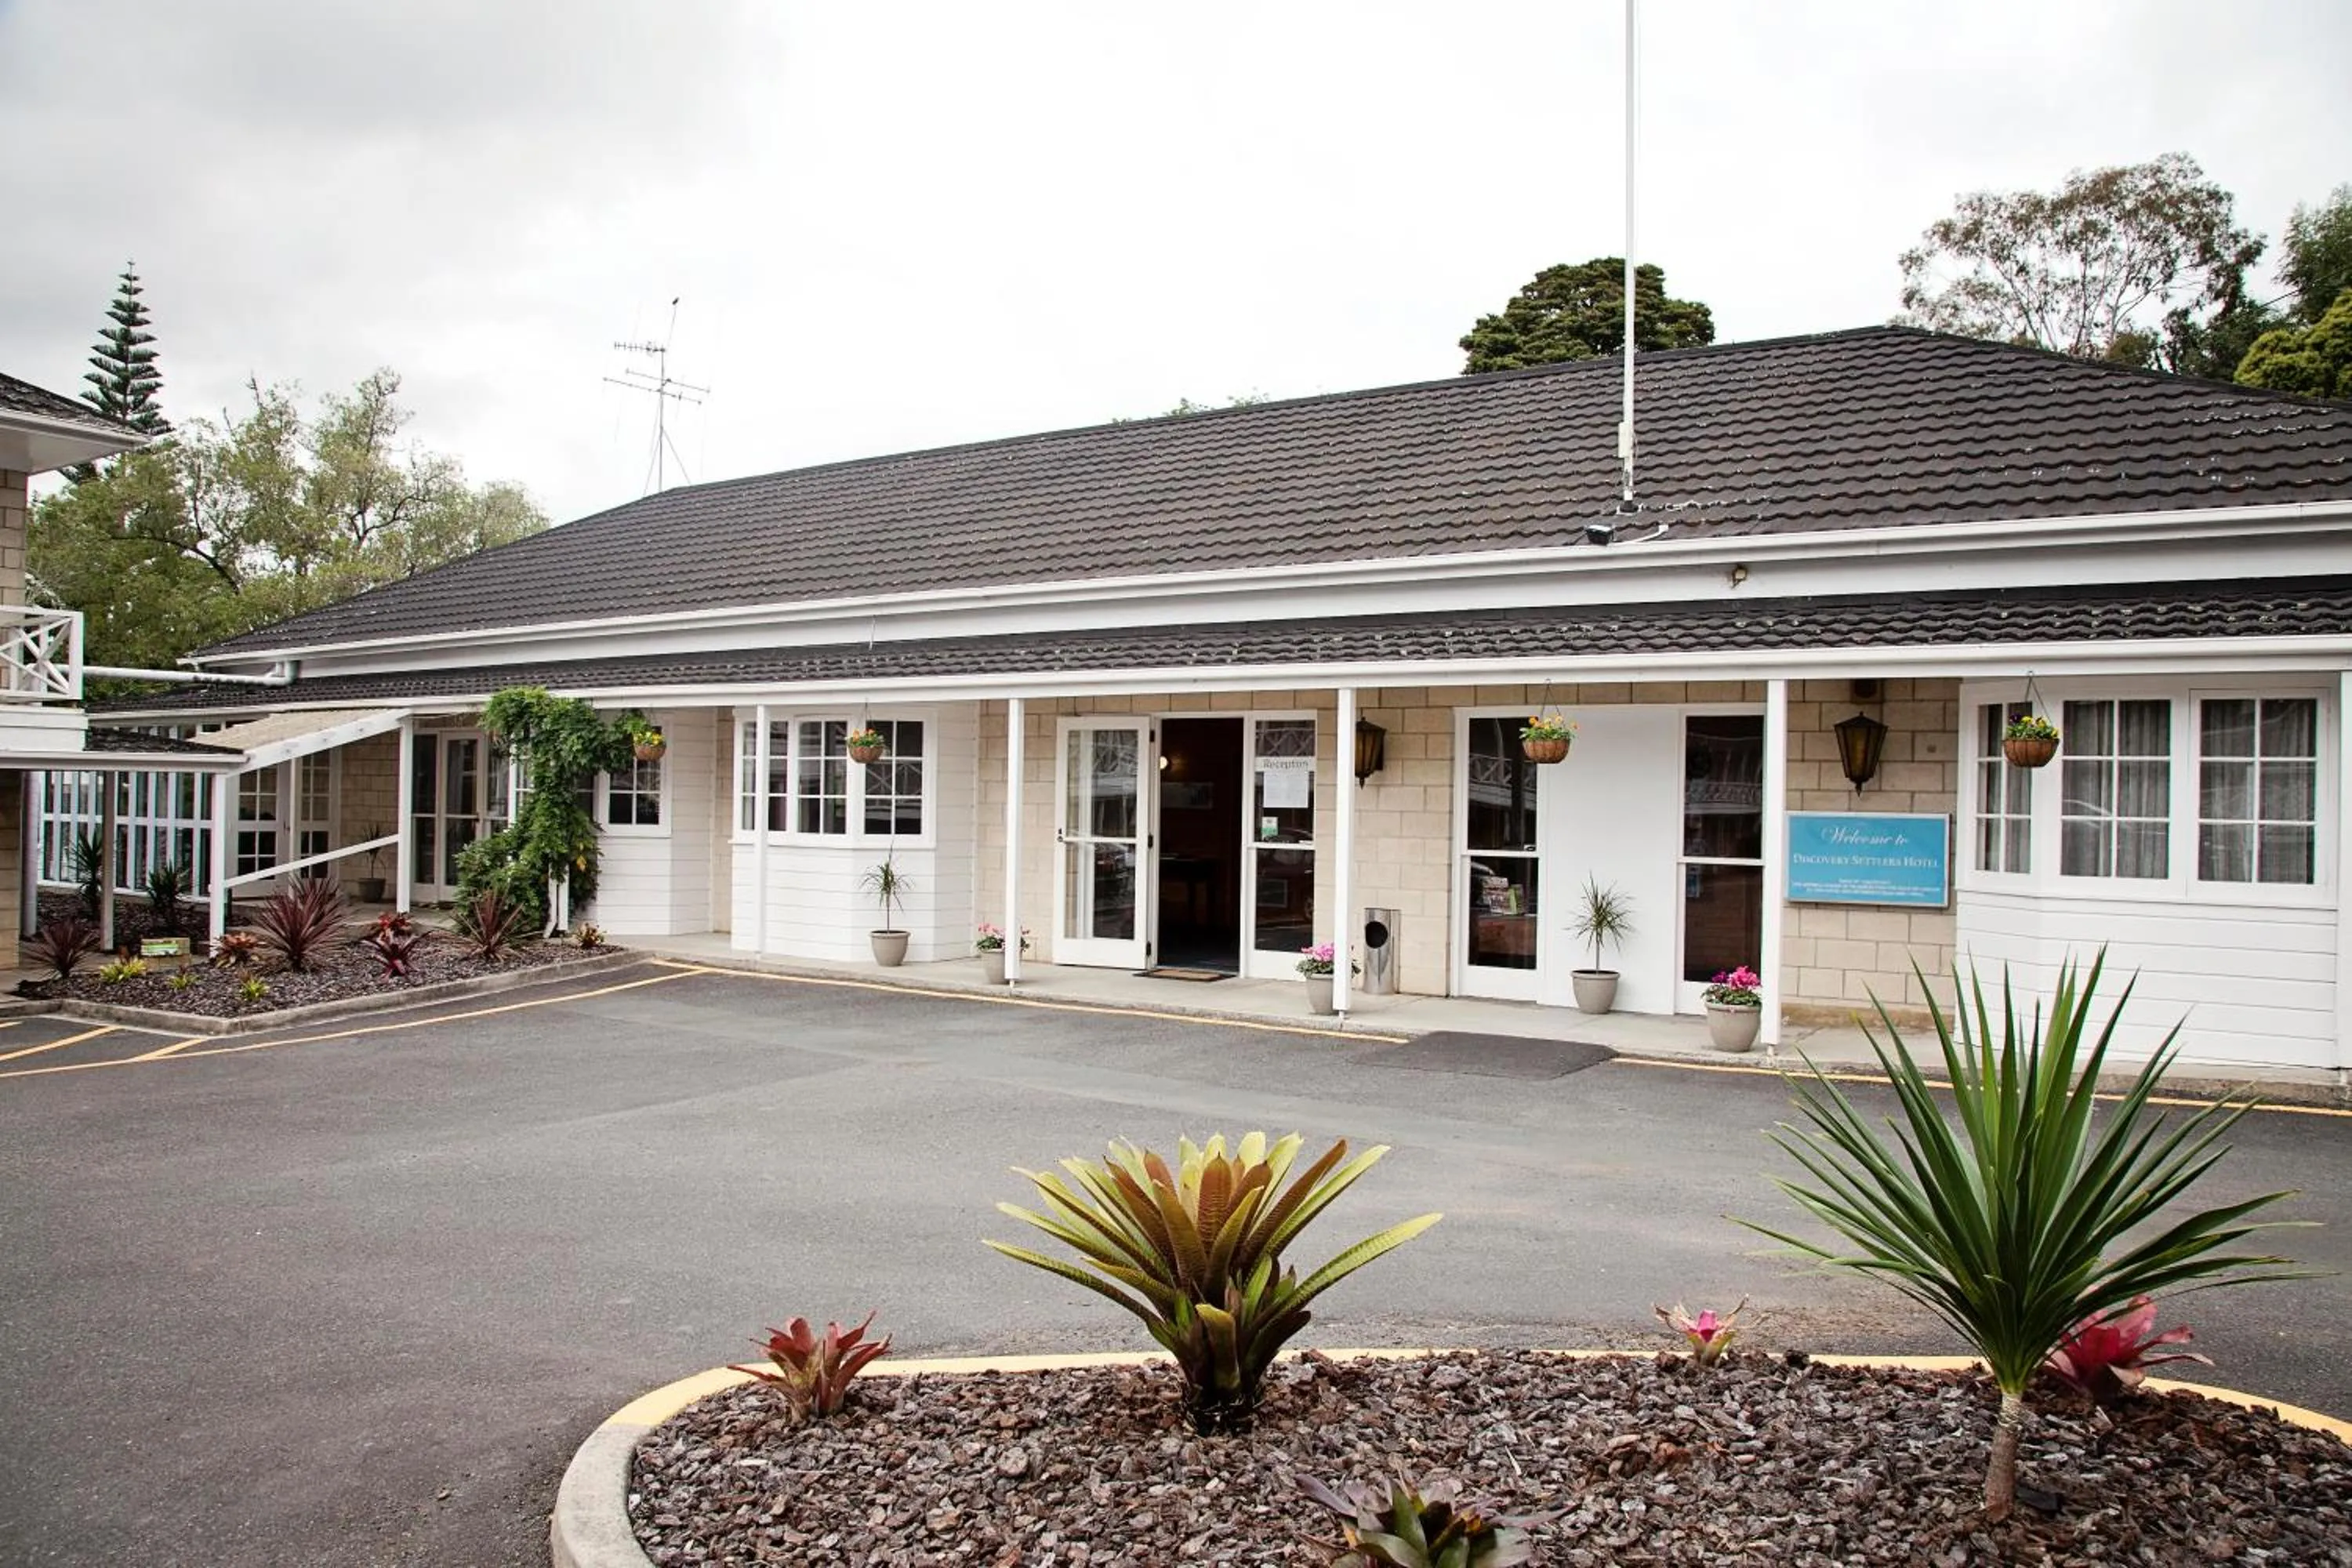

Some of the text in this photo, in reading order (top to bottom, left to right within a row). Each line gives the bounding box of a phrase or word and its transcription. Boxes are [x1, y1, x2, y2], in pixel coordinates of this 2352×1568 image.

[1821, 826, 1907, 845] Welcome to
[1793, 854, 1938, 867] DISCOVERY SETTLERS HOTEL
